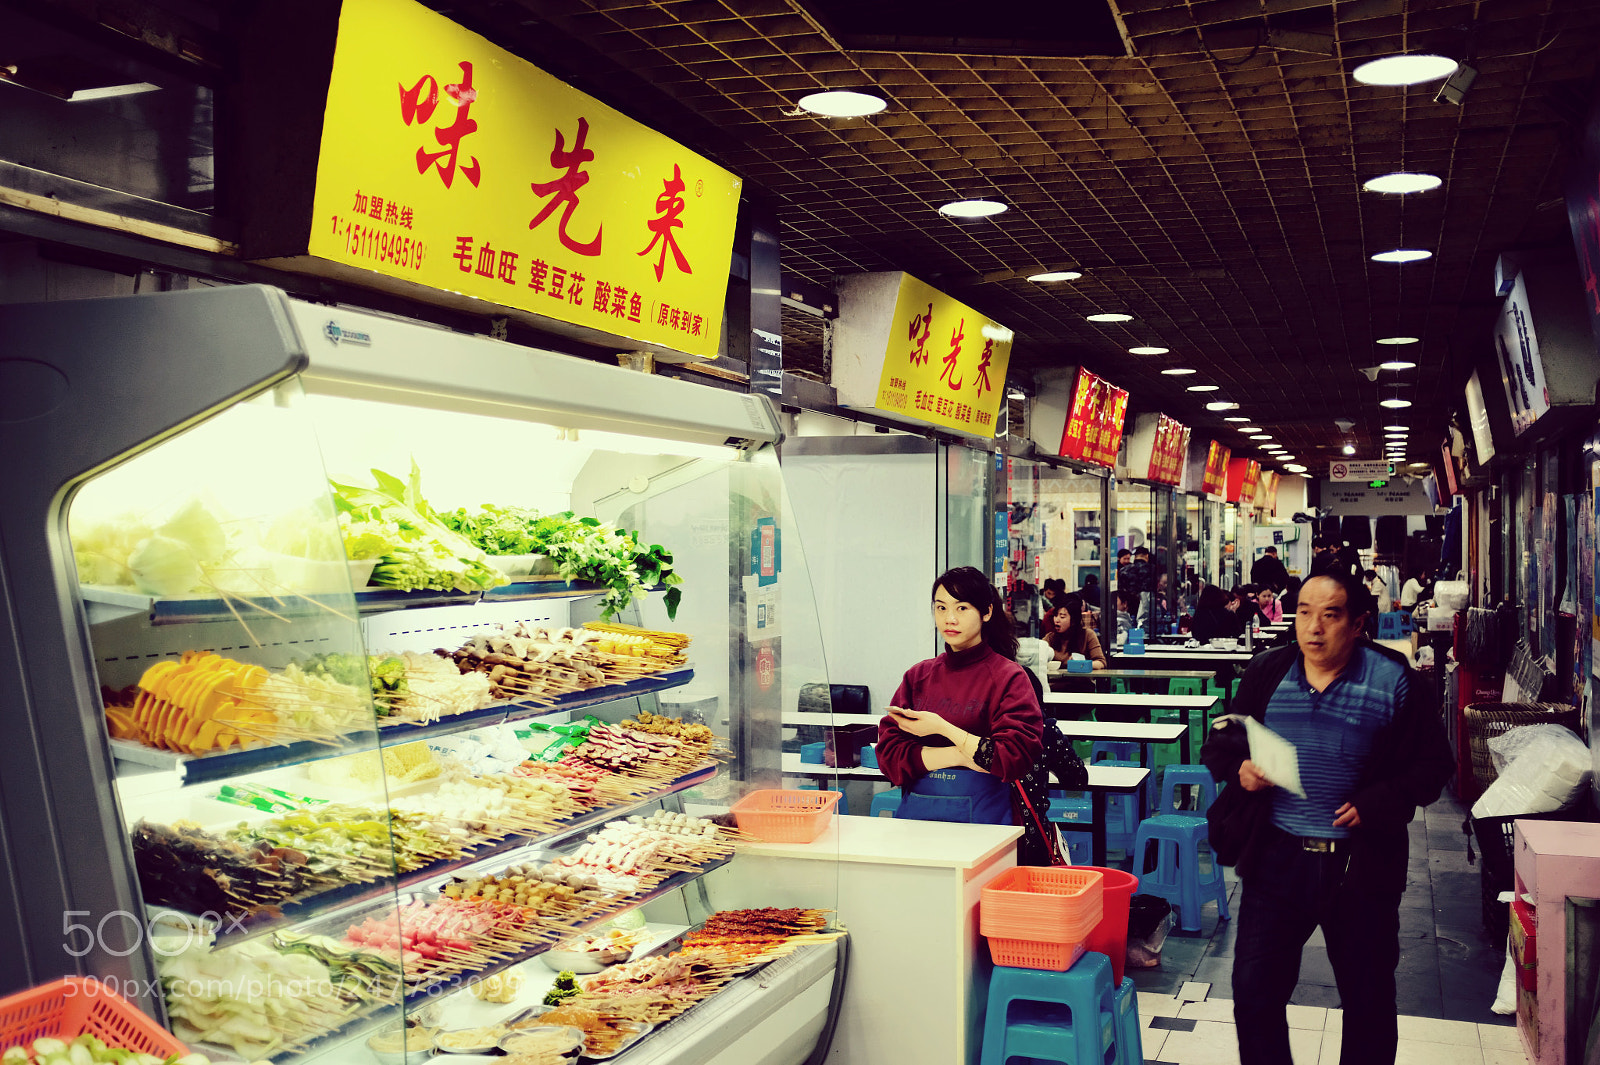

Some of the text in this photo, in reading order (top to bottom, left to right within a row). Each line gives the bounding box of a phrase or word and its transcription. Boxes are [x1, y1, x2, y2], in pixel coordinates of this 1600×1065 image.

[353, 189, 413, 230] 加盟热线
[452, 236, 519, 285] 毛血旺
[528, 259, 585, 306] 荤豆花
[593, 280, 642, 324] 酸菜鱼
